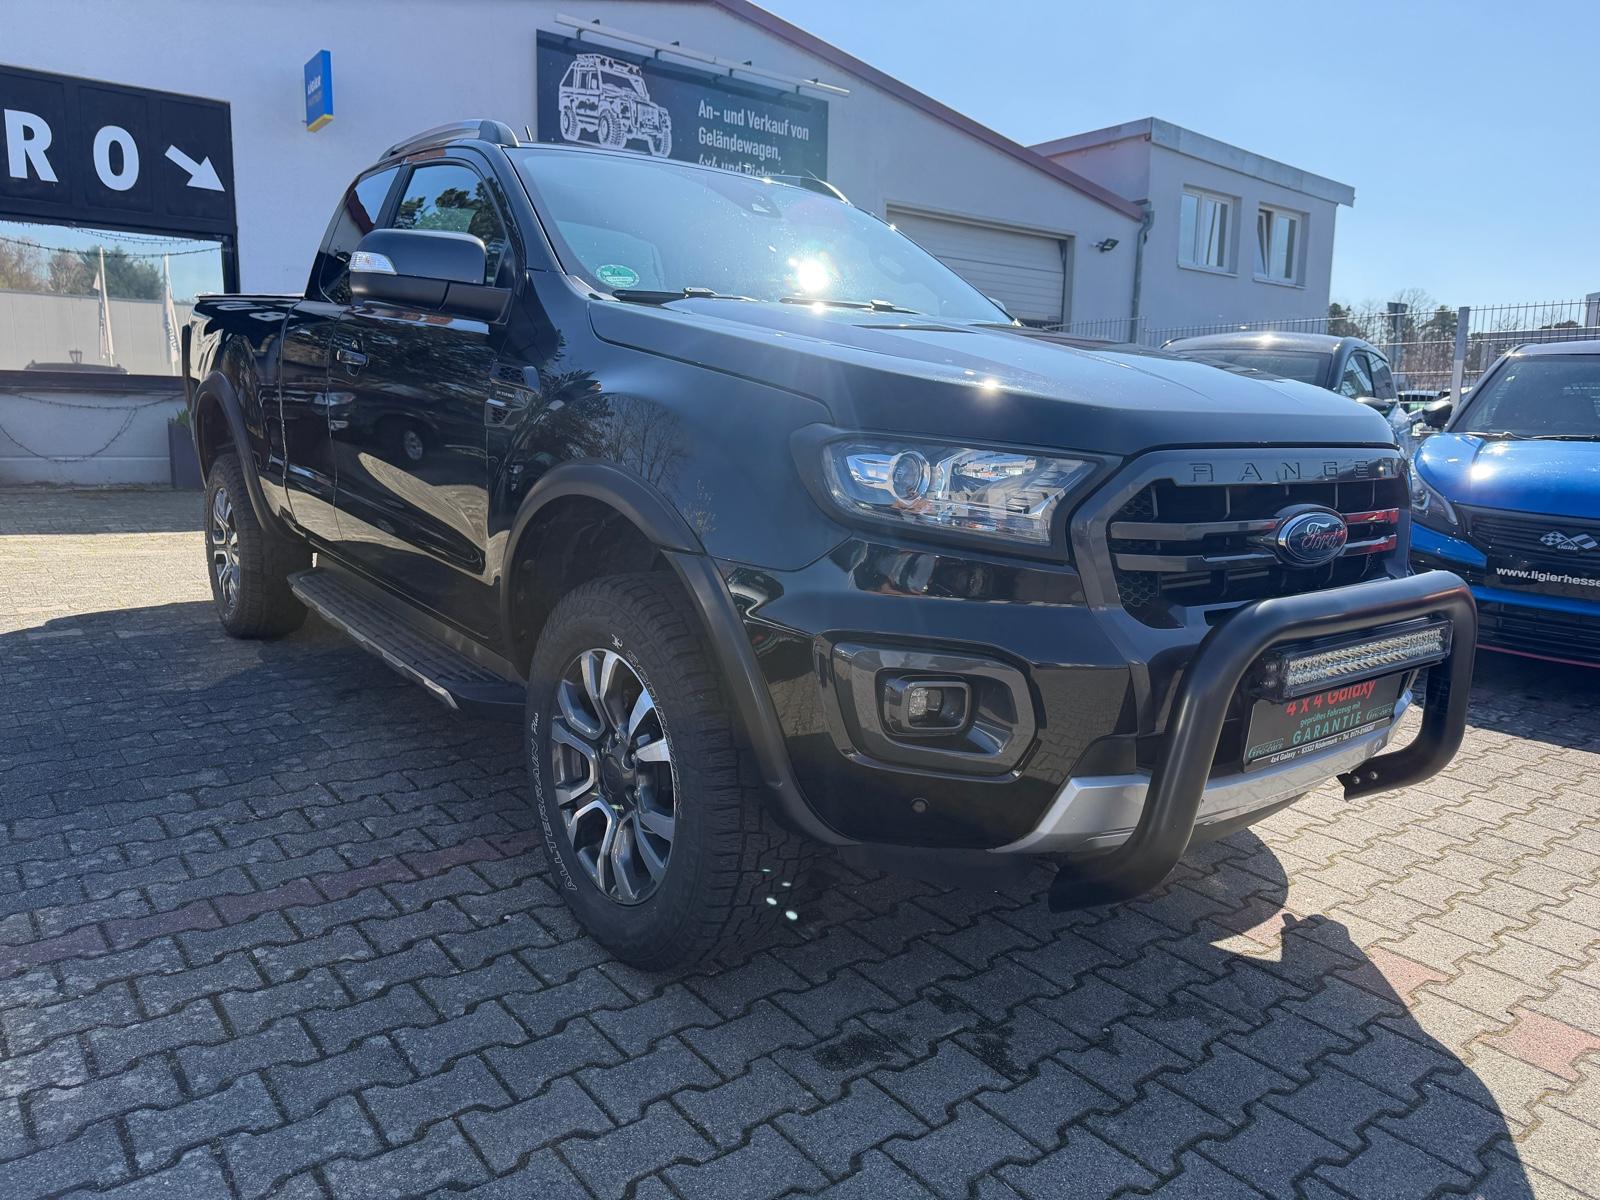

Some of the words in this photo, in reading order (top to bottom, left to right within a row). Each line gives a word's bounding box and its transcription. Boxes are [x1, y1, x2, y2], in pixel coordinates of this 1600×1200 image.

[698, 99, 720, 119] An-
[723, 108, 745, 126] und
[747, 110, 789, 136] Verkauf
[790, 124, 809, 141] von
[698, 126, 782, 161] Geländewagen,
[1301, 522, 1347, 551] Ford
[1292, 711, 1362, 745] GARANTIE
